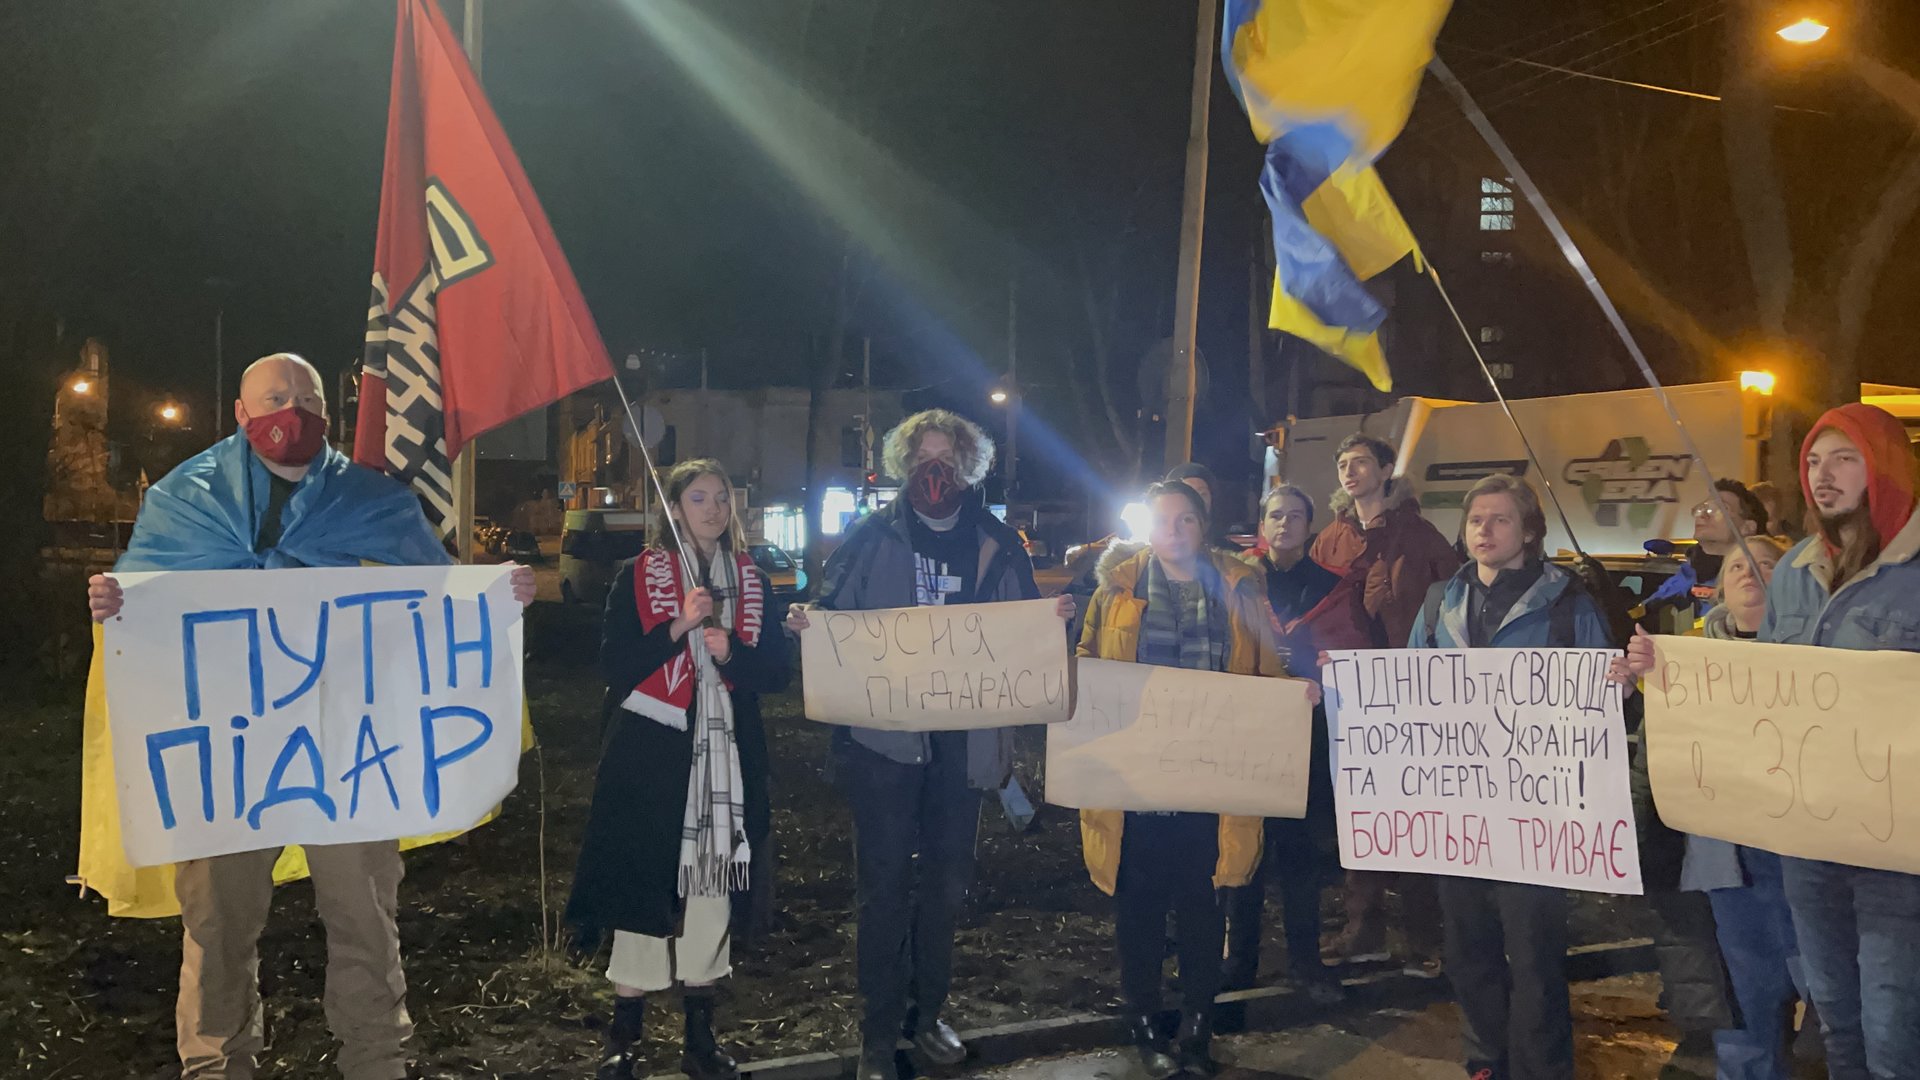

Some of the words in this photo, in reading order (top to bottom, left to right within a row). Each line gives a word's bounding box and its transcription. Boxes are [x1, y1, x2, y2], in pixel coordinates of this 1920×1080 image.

[865, 669, 1064, 717] ПІДАРАСИ
[1479, 672, 1508, 705] ТА
[1342, 766, 1377, 796] ТА
[1401, 765, 1498, 798] СМЕРТЬ
[1753, 718, 1895, 843] ЗСУ
[1351, 810, 1493, 868] БОРОТЬБА
[1507, 817, 1628, 880] ТРИВАЄ
